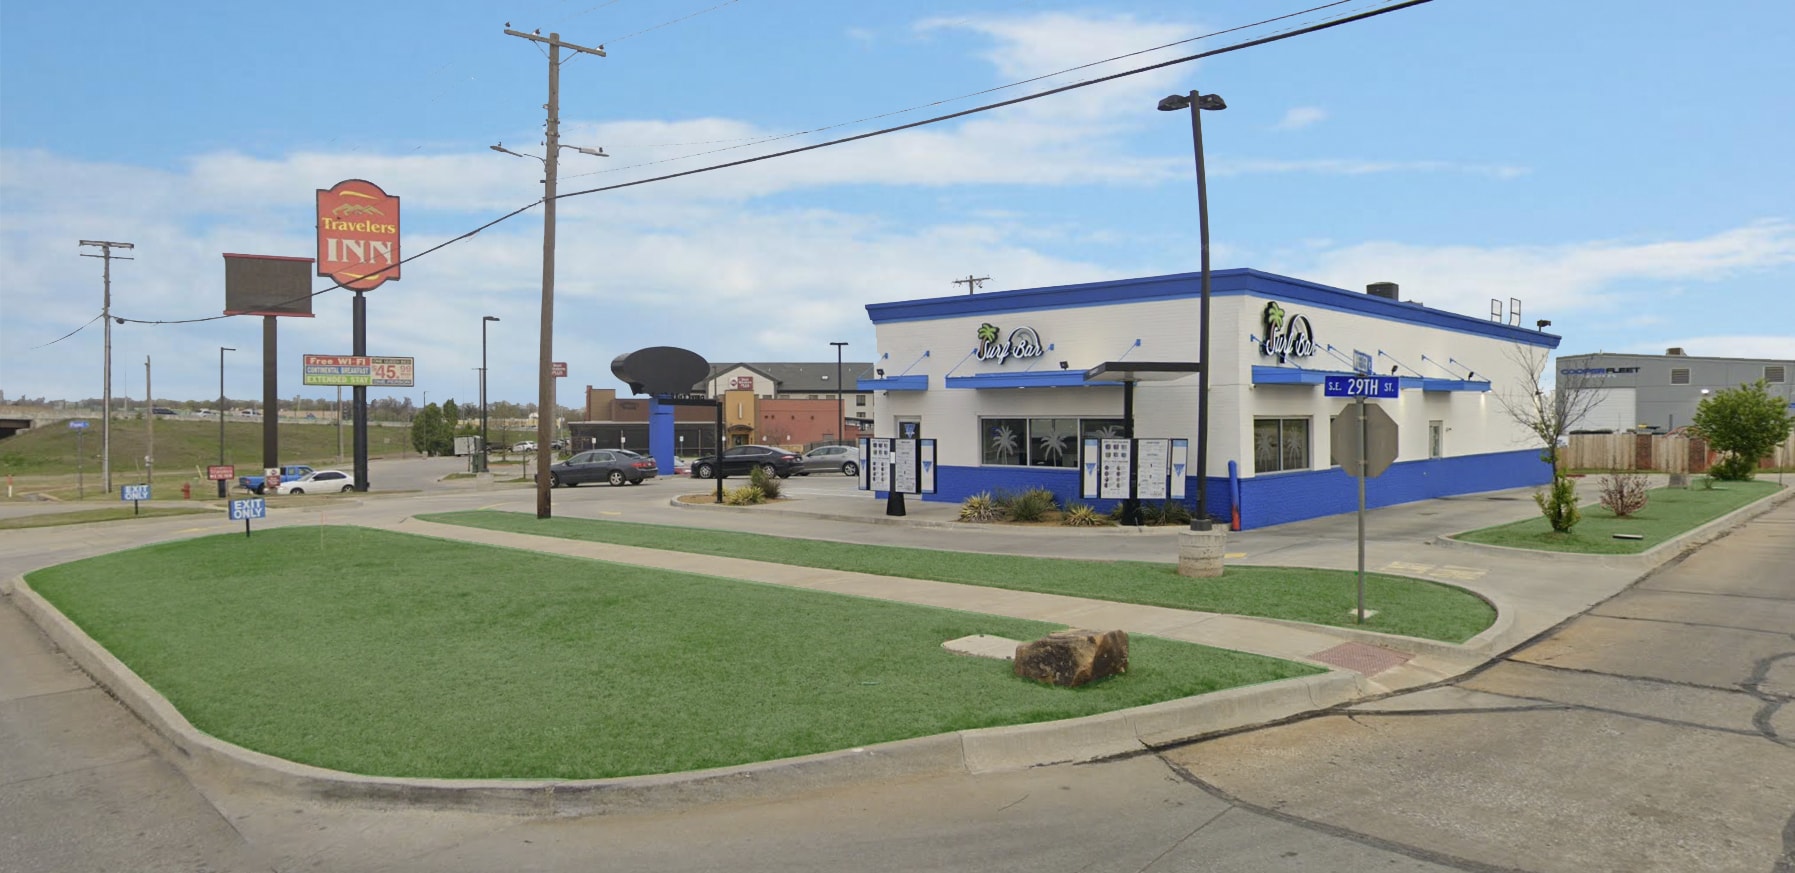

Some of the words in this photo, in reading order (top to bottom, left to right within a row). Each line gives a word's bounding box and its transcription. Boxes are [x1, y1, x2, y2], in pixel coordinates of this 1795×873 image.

[322, 217, 396, 234] Travelers
[326, 237, 393, 265] INN
[1266, 326, 1294, 363] Surf
[1295, 332, 1316, 357] Bar
[976, 340, 1010, 365] Surf
[1012, 340, 1043, 358] Bar
[310, 357, 334, 365] Free
[307, 375, 347, 383] EXTENDED
[351, 376, 370, 384] STAY
[1328, 381, 1342, 391] S.E.
[1347, 378, 1379, 396] 29TH
[1384, 382, 1395, 392] ST.
[125, 485, 148, 493] EXIT
[124, 491, 149, 500] ONLY
[234, 500, 262, 509] EXIT
[233, 508, 263, 519] ONLY
